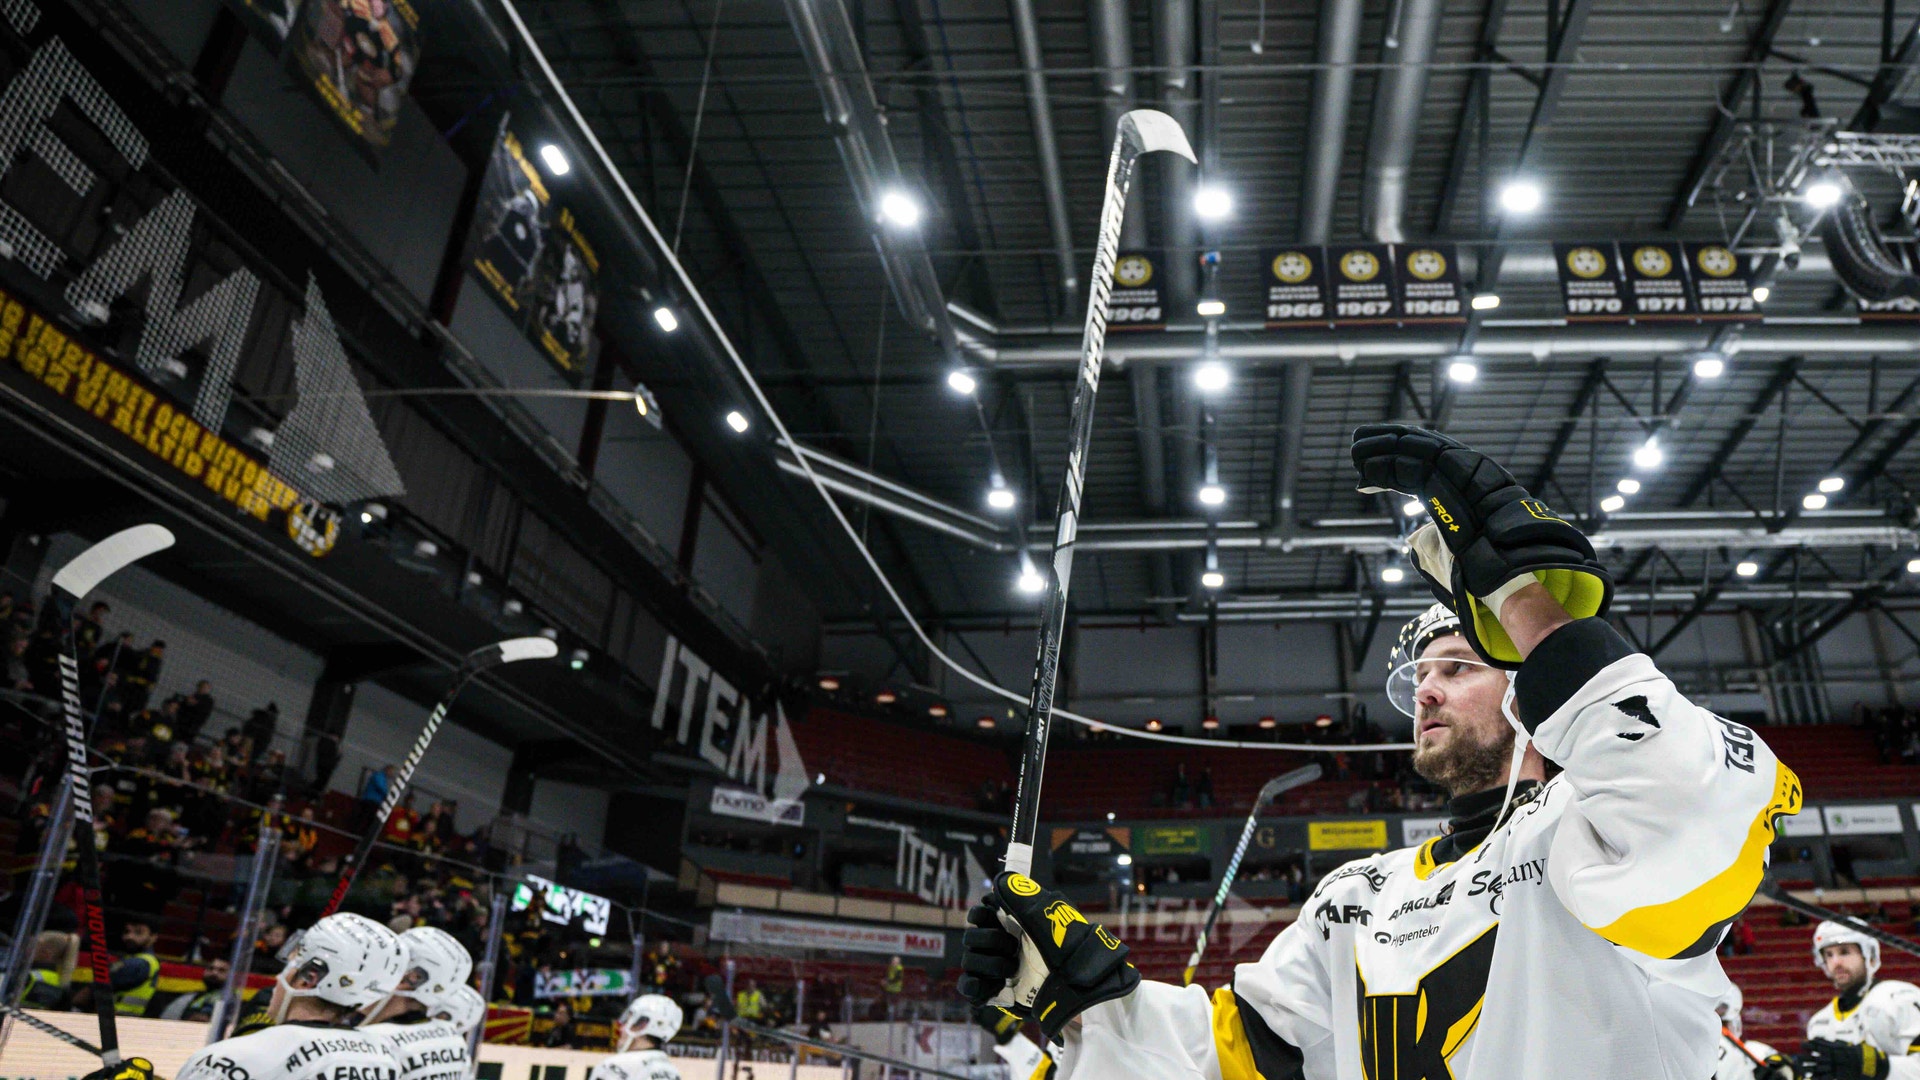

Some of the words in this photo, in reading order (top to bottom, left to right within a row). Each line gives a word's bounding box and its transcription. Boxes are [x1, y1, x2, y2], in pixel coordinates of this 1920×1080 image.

[1267, 302, 1324, 318] 1966
[1337, 300, 1392, 316] 1967
[1404, 299, 1460, 315] 1968
[1566, 298, 1623, 313] 1970
[1637, 297, 1686, 312] 1971
[1701, 296, 1753, 312] 1972
[110, 404, 204, 478] ALLTID
[154, 402, 200, 450] OCH
[1429, 496, 1461, 533] PRO+
[1037, 630, 1059, 713] ALPHA
[651, 634, 769, 798] ITEM
[58, 653, 94, 824] WARRIOR
[376, 702, 448, 825] WARRIOR
[1255, 827, 1276, 849] G
[896, 826, 960, 911] ITEM
[1118, 892, 1222, 944] ITEM
[1391, 924, 1440, 947] Hygientekn
[87, 902, 112, 983] NOVIUM
[300, 1038, 377, 1062] Hisstech
